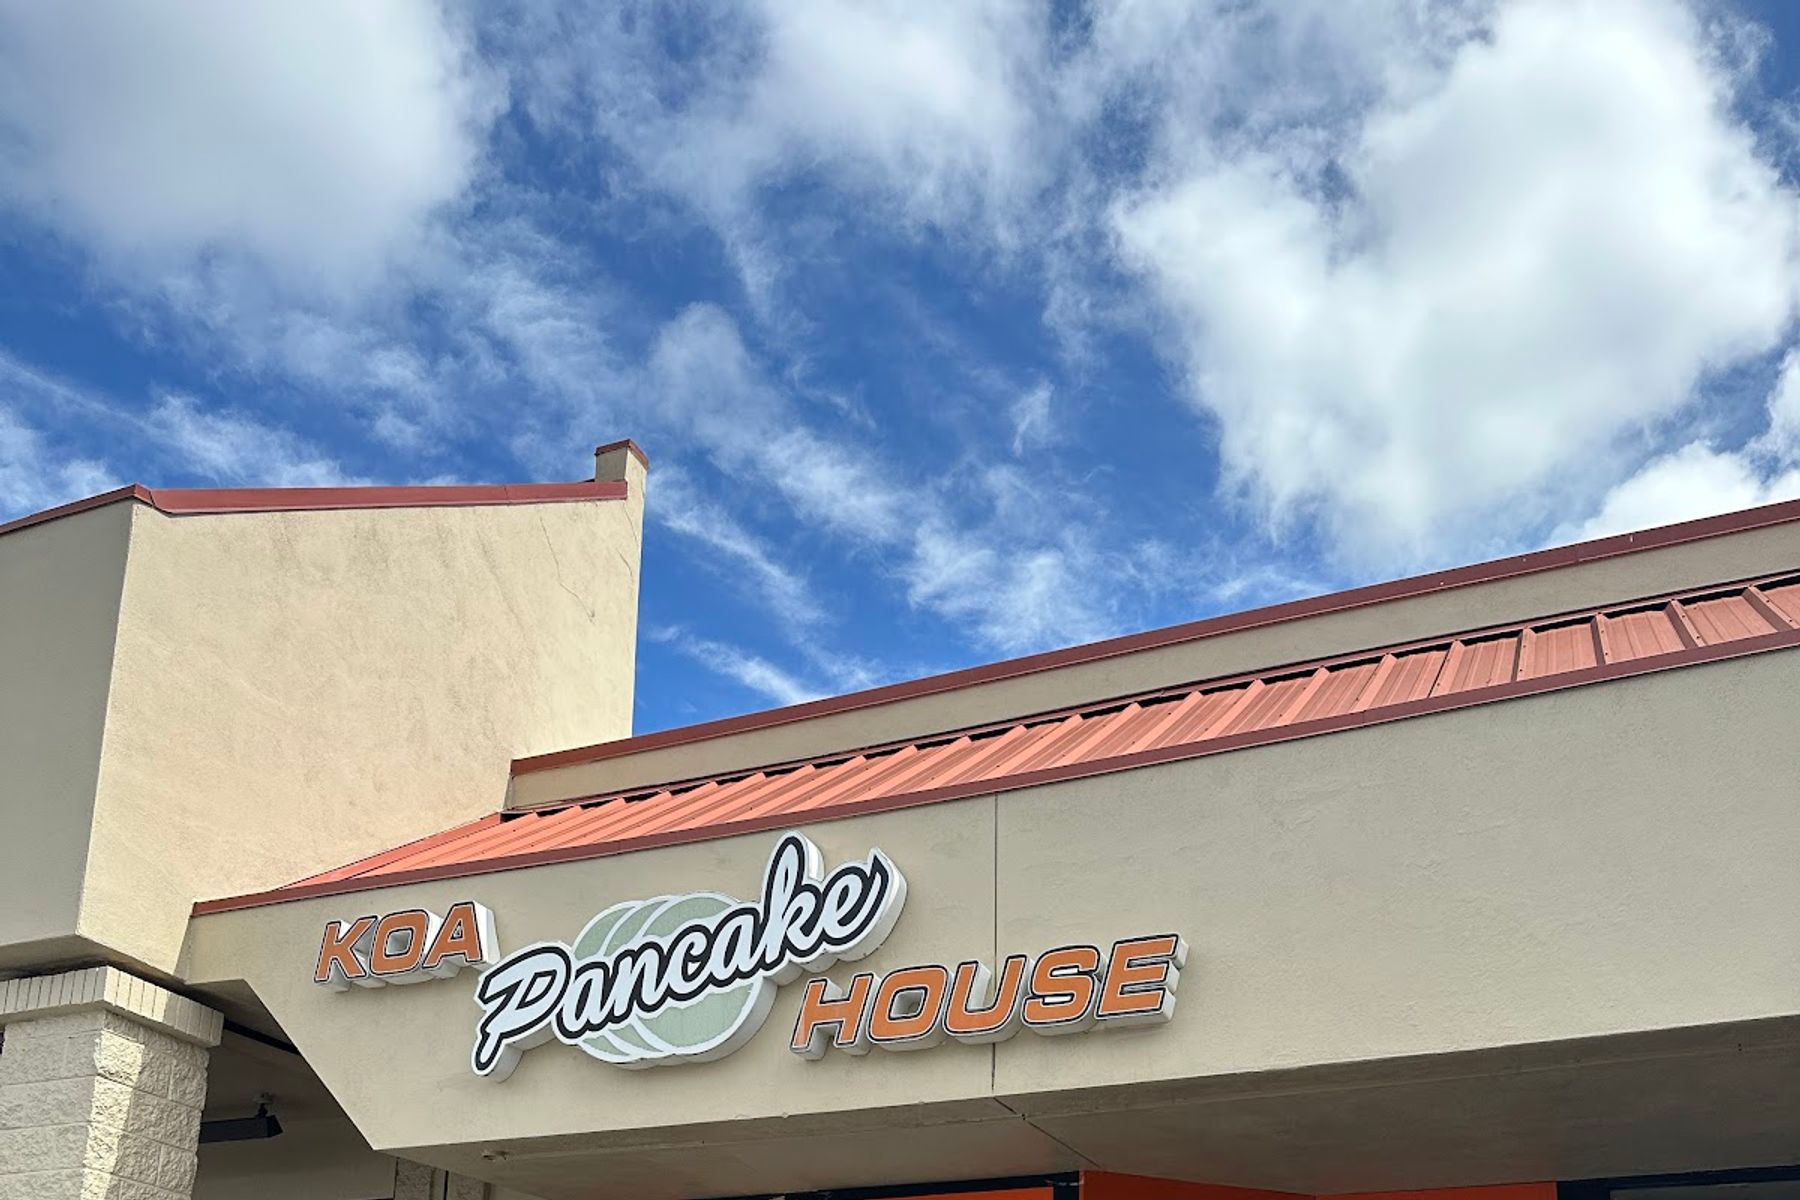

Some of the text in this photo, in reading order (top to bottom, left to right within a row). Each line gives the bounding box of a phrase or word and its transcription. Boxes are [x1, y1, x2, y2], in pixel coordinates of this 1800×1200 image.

[315, 900, 484, 982] KOA
[473, 833, 888, 1072] Pancake
[791, 934, 1180, 1052] HOUSE
